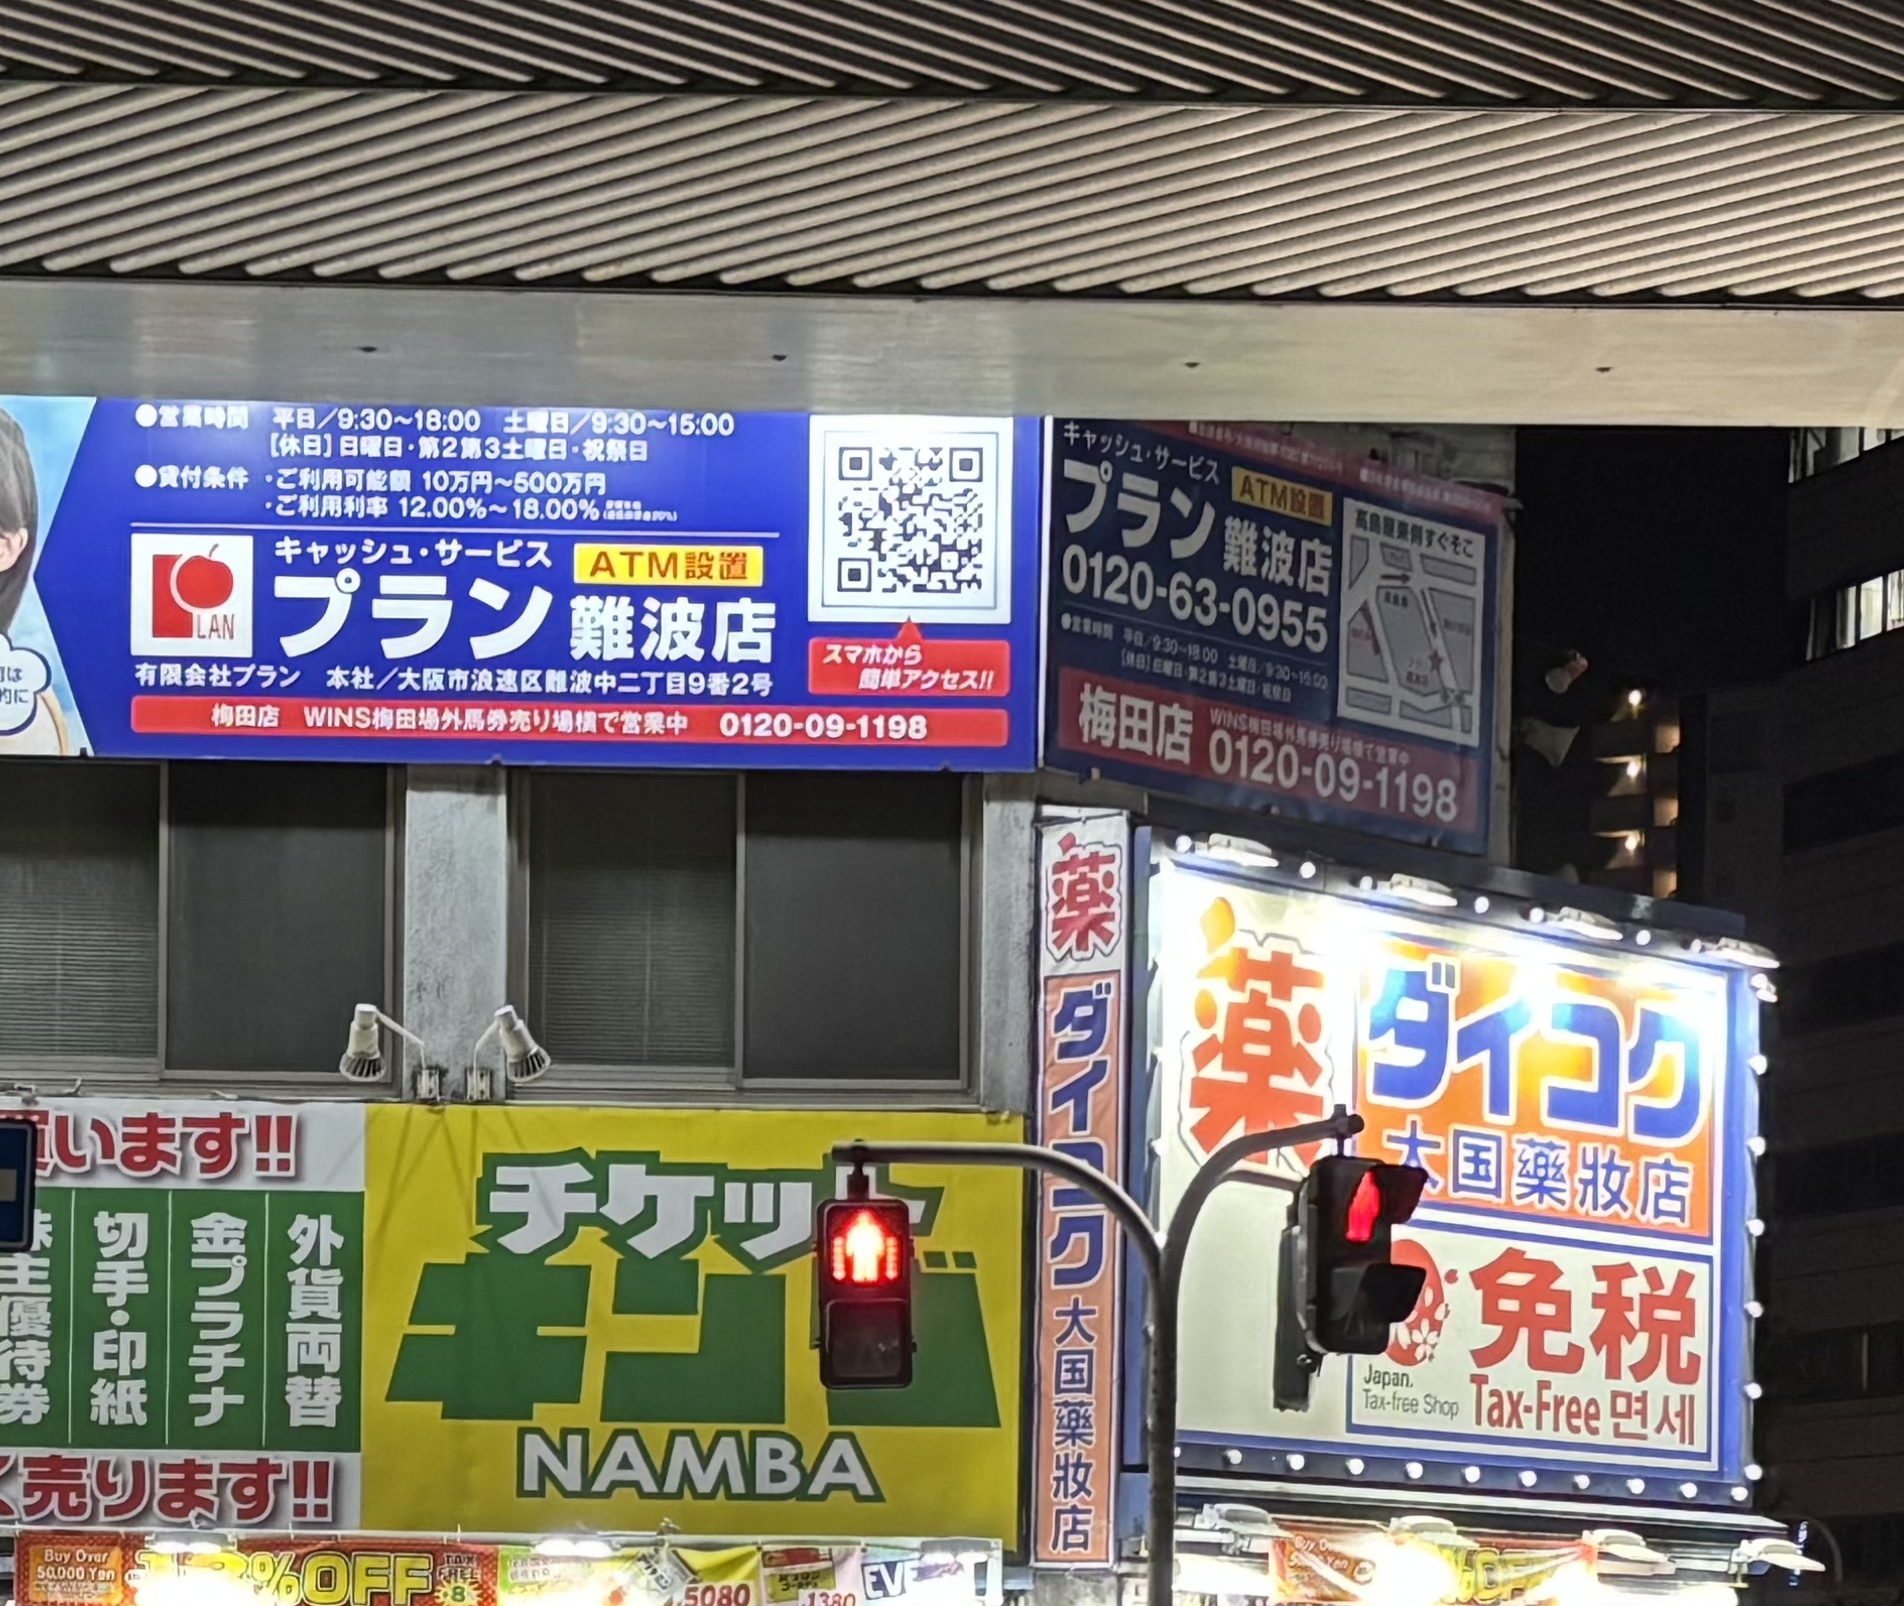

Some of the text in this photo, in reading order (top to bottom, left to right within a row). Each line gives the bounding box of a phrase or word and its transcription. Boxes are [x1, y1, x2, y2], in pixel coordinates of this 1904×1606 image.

[589, 550, 749, 582] ATM設置
[1062, 459, 1332, 596] プラン 難波店
[274, 567, 775, 664] プラン 難波店
[1063, 546, 1328, 653] 0120-63-0955
[134, 663, 300, 688] 有限会社プラン
[822, 643, 922, 665] スマホから
[211, 704, 280, 728] 梅田店
[718, 711, 928, 739] 0120-09-1198
[1078, 684, 1193, 764] 梅田店
[1209, 731, 1457, 822] 0120-09-1198
[1050, 834, 1115, 950] 薬
[1191, 898, 1324, 1168] 薬
[1369, 962, 1697, 1139] ダイコク
[286, 1214, 343, 1430] 外貨両替
[1470, 1246, 1701, 1386] 免税
[1423, 1395, 1459, 1419] Shop
[1470, 1374, 1600, 1436] Tax-Free
[1609, 1389, 1696, 1445] 면세
[523, 1432, 878, 1496] NAMBA
[45, 1549, 72, 1566] Buy
